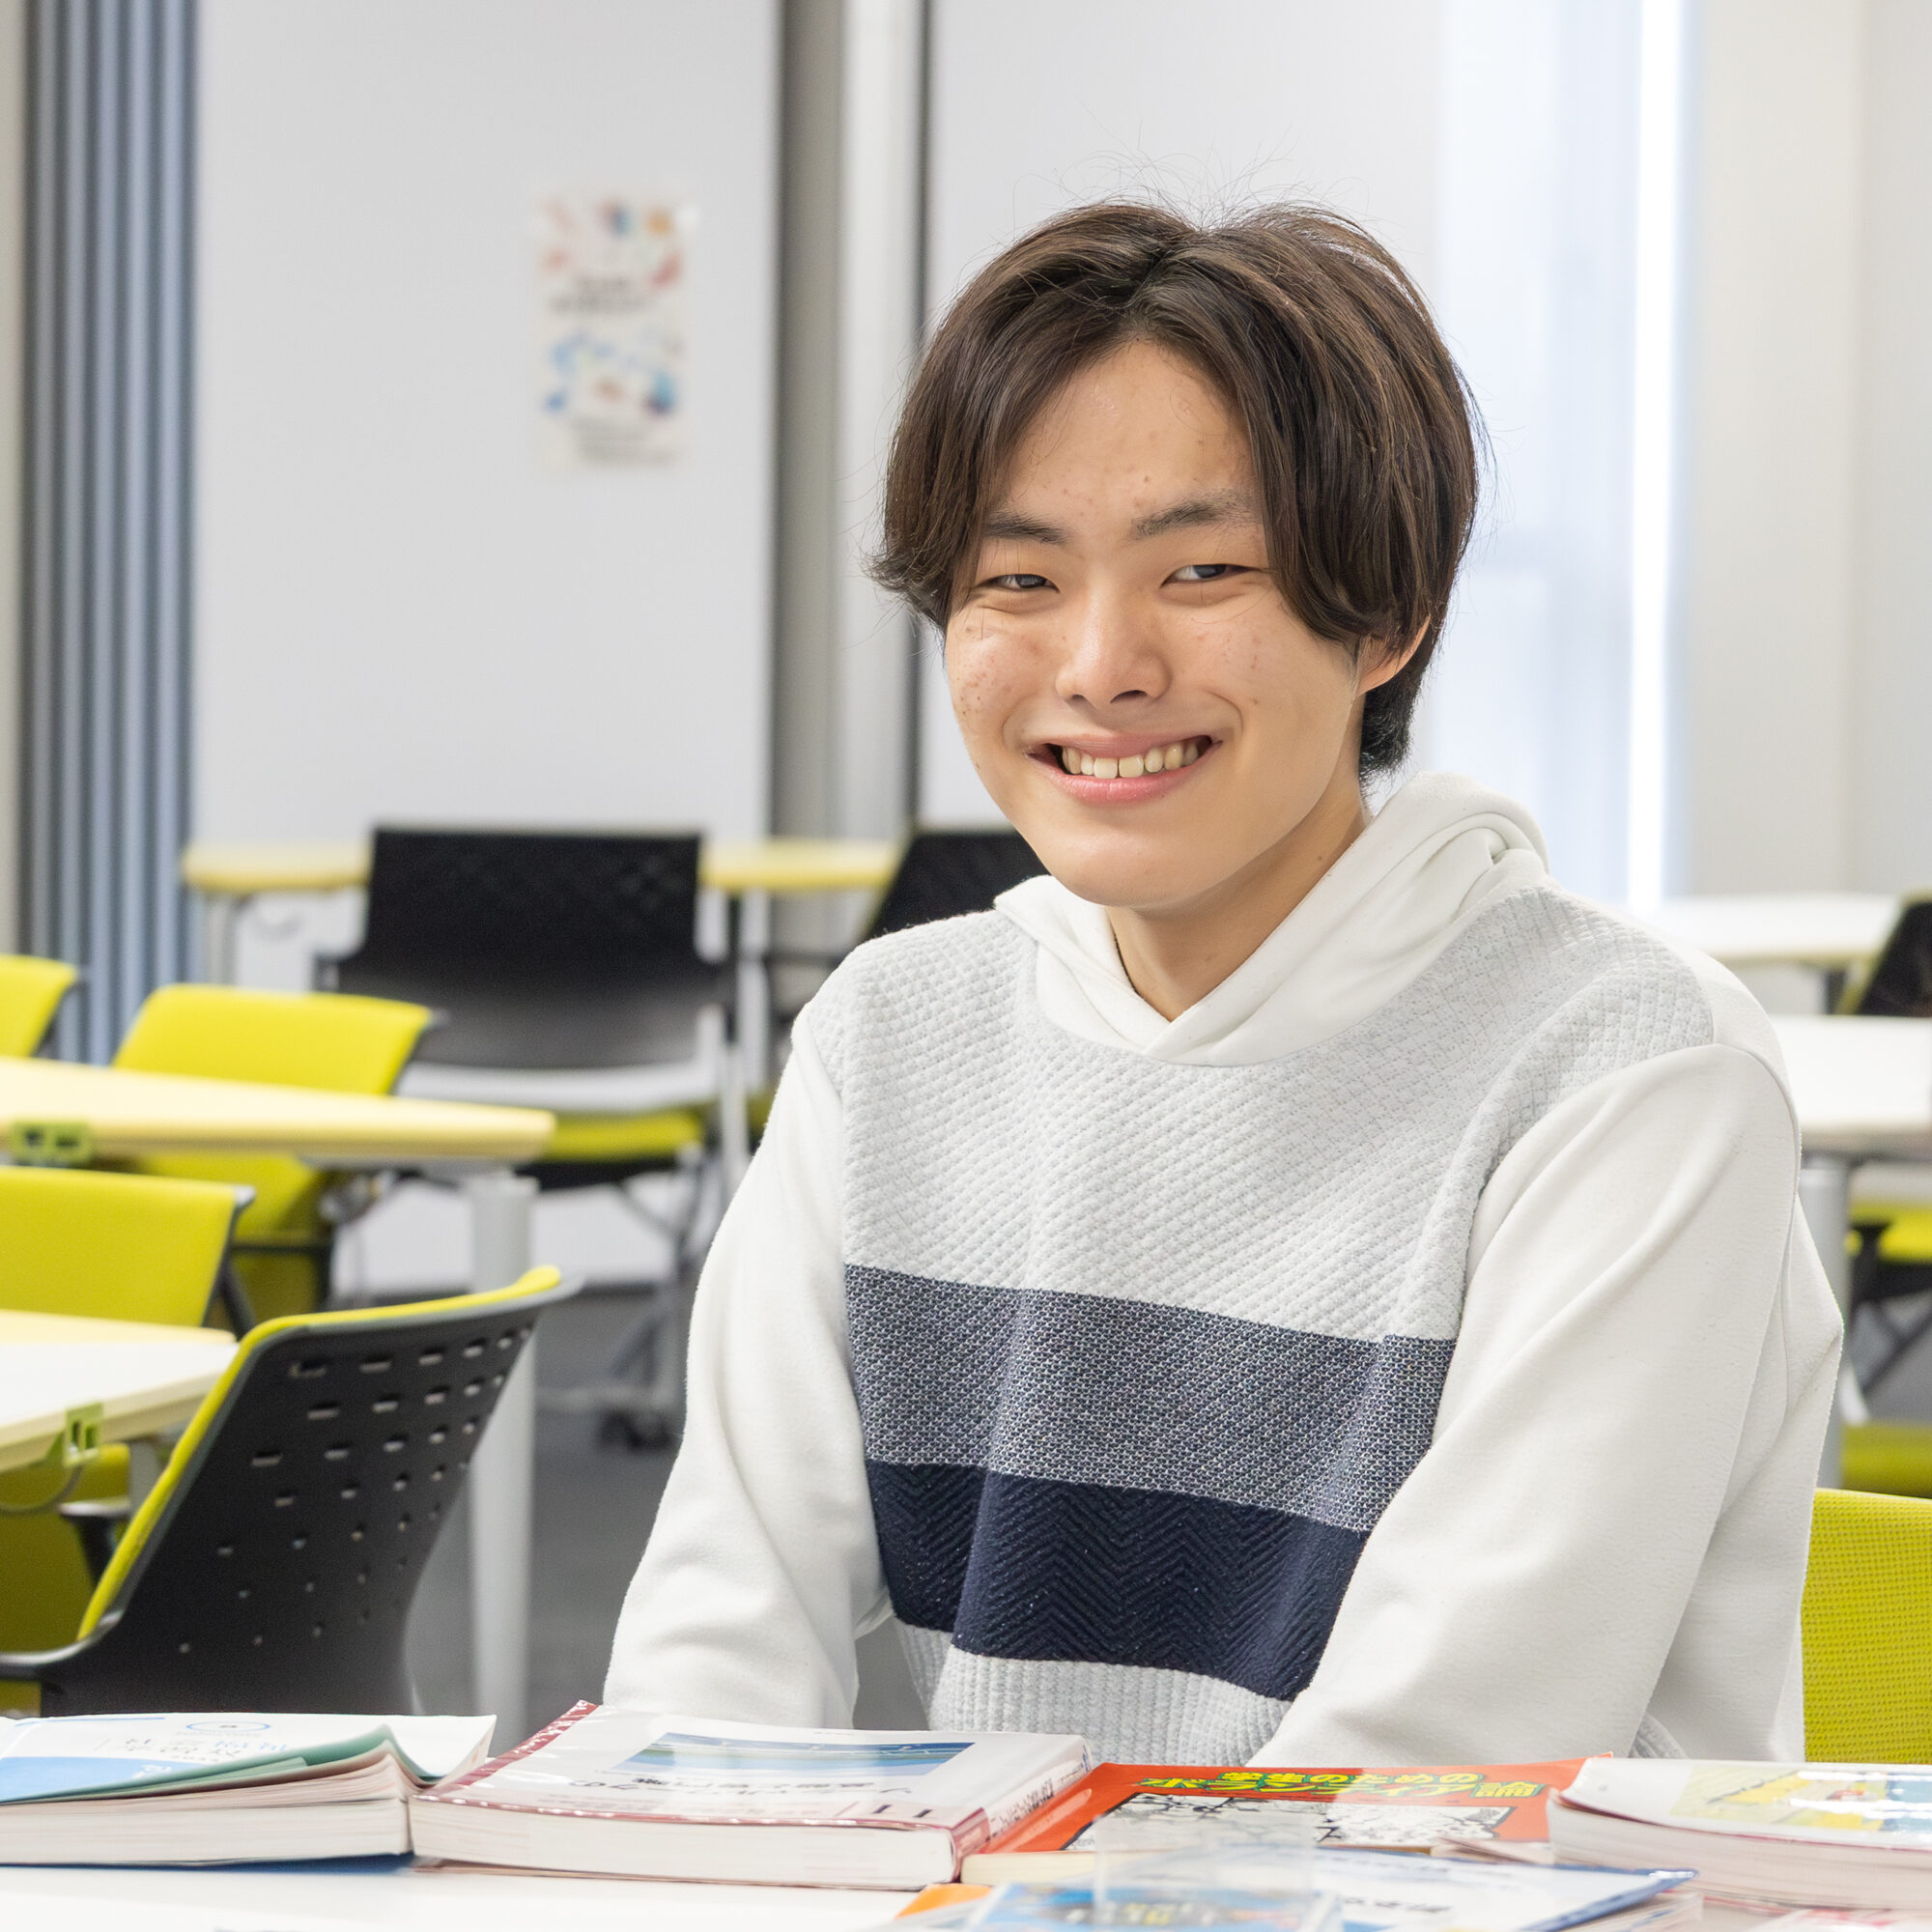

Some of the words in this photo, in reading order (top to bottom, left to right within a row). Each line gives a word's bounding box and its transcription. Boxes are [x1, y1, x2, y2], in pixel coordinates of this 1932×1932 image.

[1219, 1771, 1485, 1784] 学生のための
[1138, 1777, 1547, 1798] ボランティア論
